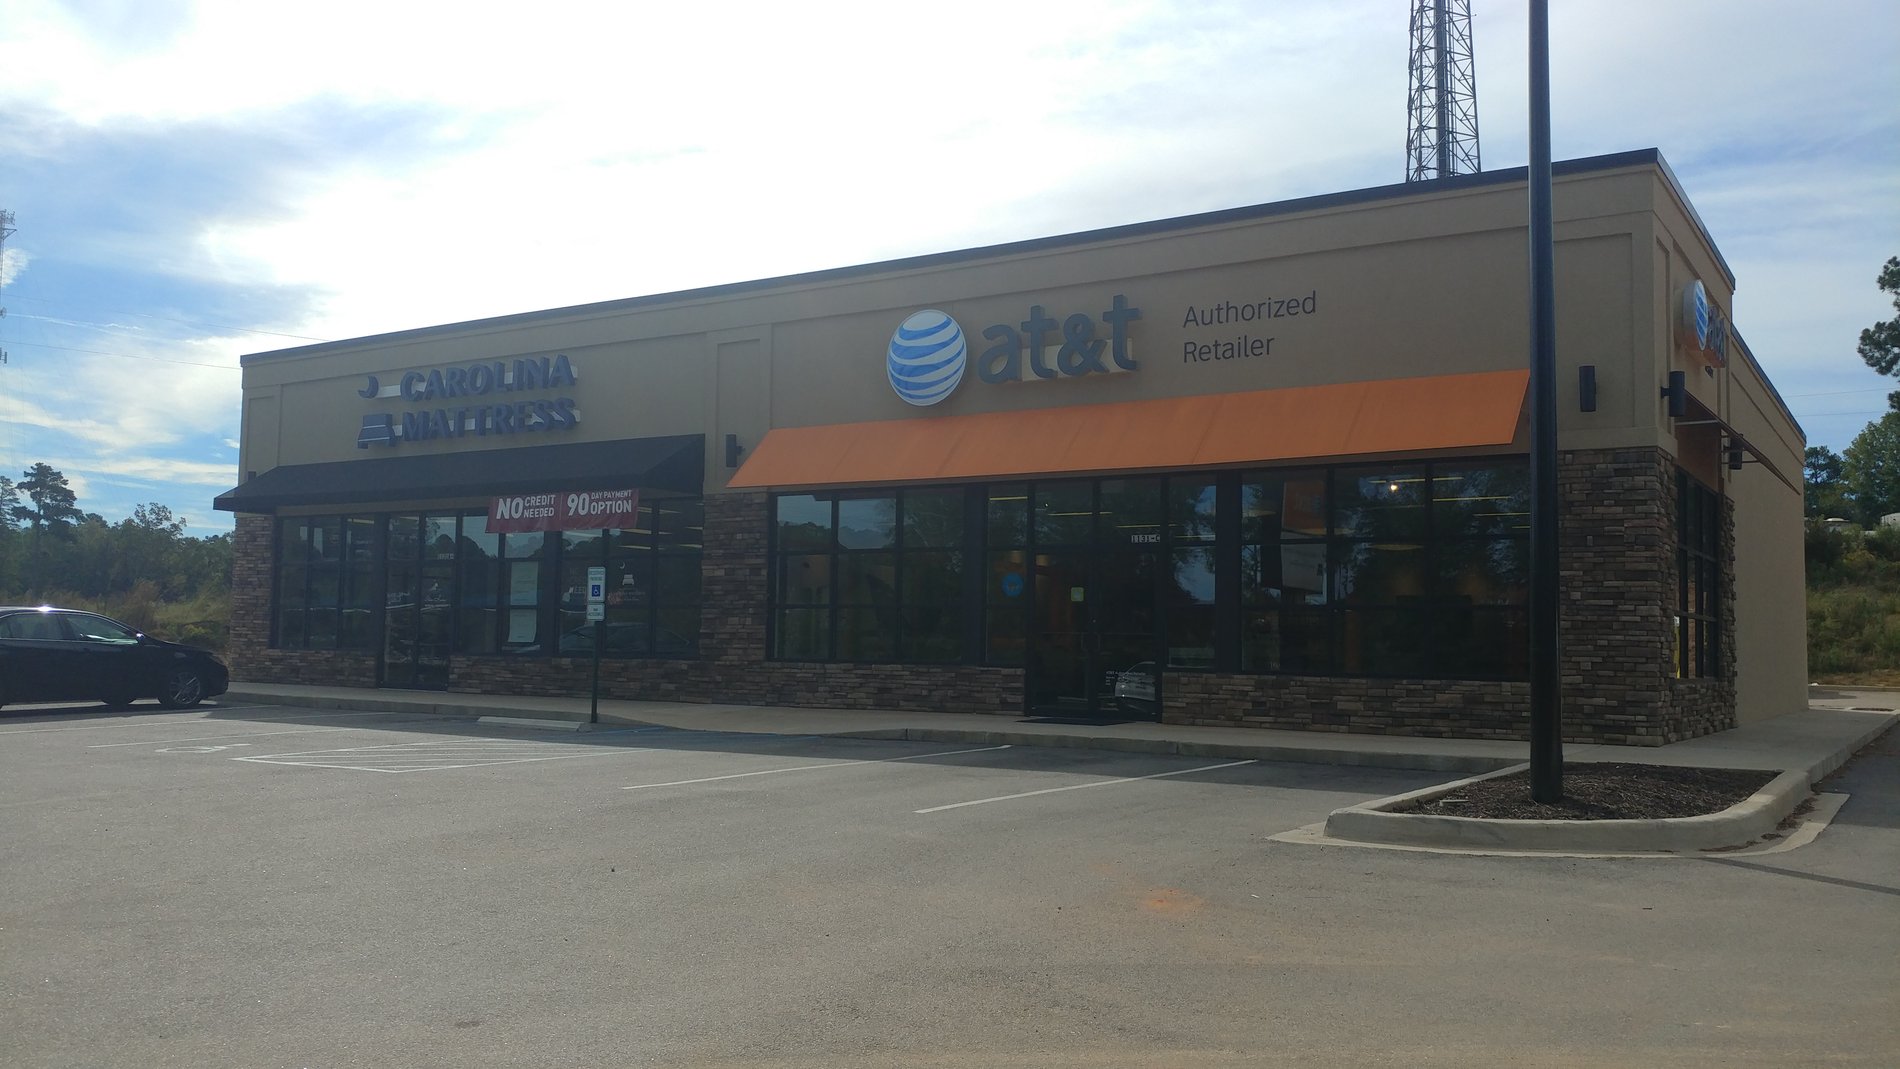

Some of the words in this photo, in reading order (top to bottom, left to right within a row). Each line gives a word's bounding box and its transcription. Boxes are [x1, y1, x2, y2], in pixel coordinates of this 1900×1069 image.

[1183, 290, 1317, 328] Authorized
[978, 294, 1142, 384] at&t
[1183, 336, 1275, 363] Retailer
[401, 354, 577, 400] CAROLINA
[403, 398, 577, 441] MATTRESS
[524, 495, 556, 506] CREDIT
[567, 493, 590, 516] 90
[591, 492, 602, 500] DAY
[604, 490, 632, 499] PAYMENT
[496, 497, 524, 520] NO
[524, 507, 555, 518] NEEDED
[590, 500, 632, 514] OPTION
